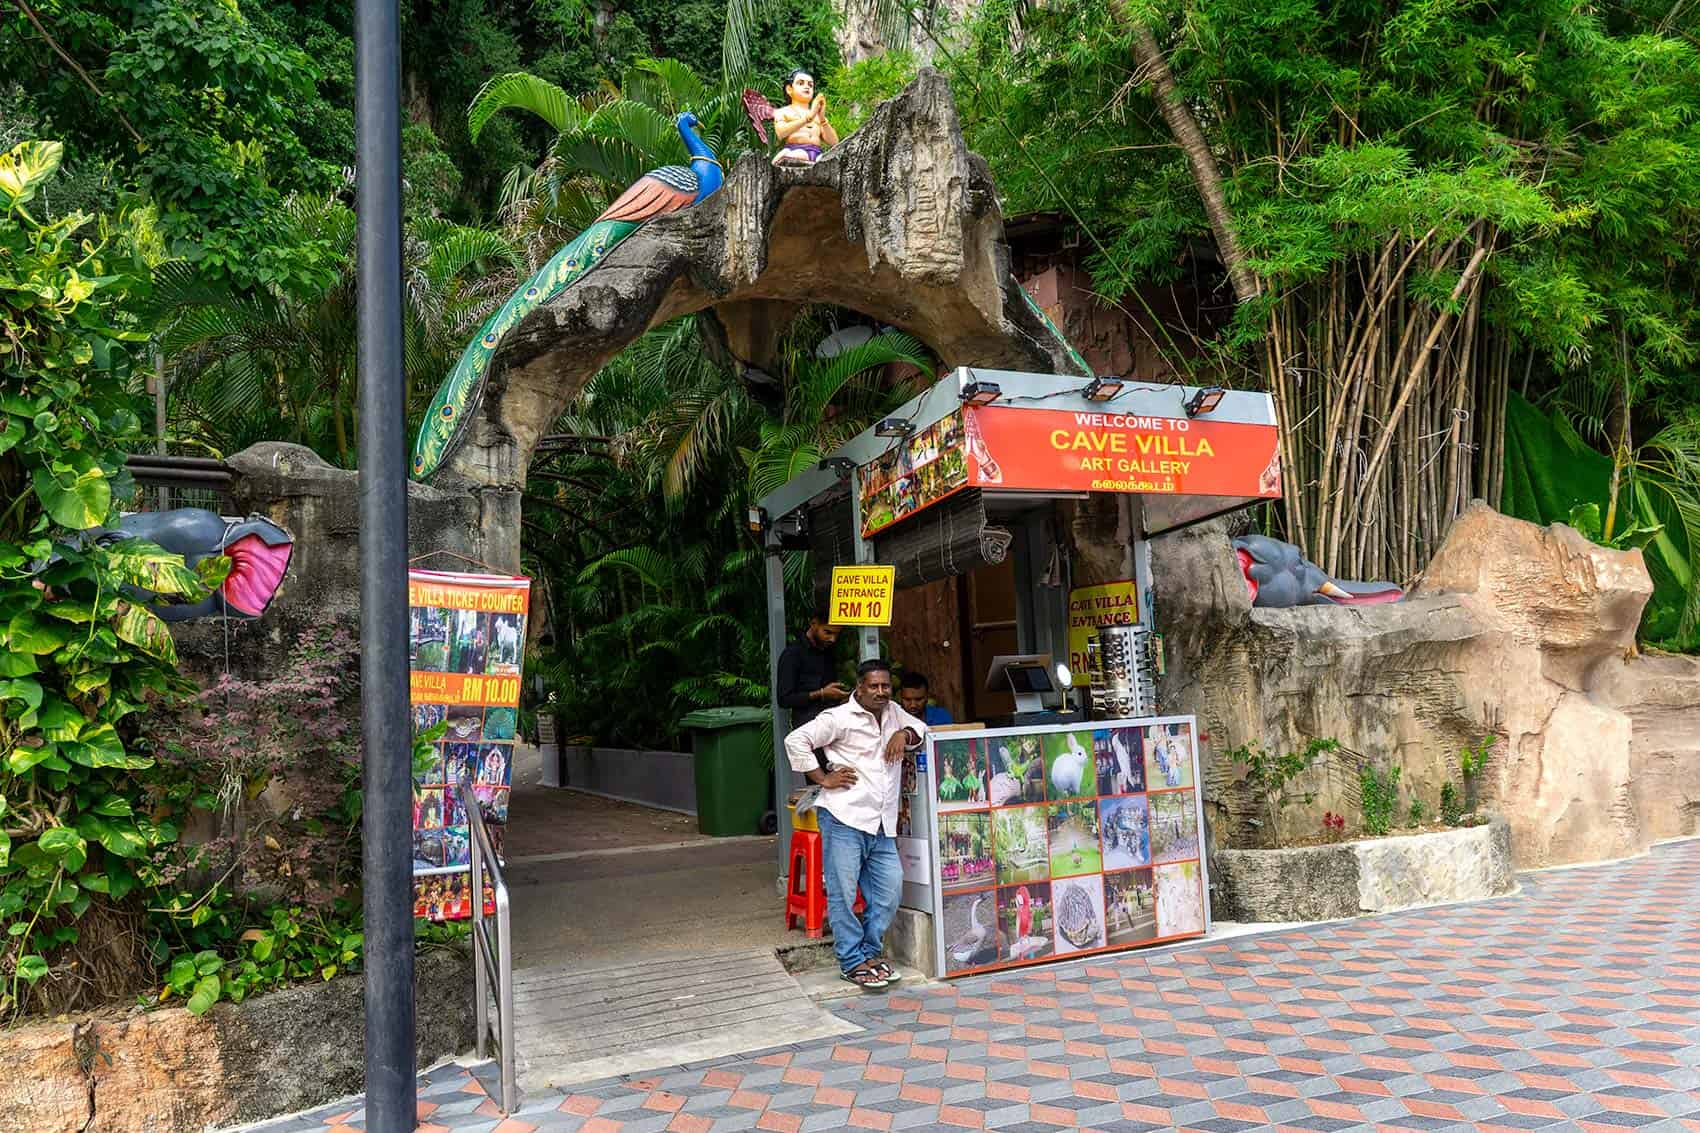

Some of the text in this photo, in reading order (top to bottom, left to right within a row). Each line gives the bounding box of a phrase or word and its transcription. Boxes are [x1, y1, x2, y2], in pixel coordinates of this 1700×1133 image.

[1074, 413, 1189, 432] WELCOME TO
[1050, 429, 1215, 457] CAVE VILLA
[1079, 458, 1191, 475] ART GALLERY
[837, 575, 888, 584] CAVE VILLA
[418, 586, 444, 605] VILLA
[447, 590, 479, 608] TICKET
[481, 593, 523, 611] COUNTER
[837, 588, 886, 598] ENTRANCE
[839, 601, 881, 618] RM 10
[1071, 594, 1134, 611] CAVE VILLA
[1071, 612, 1131, 627] ENTRANCE
[424, 674, 447, 689] VILLA
[462, 677, 483, 702] RM
[485, 678, 518, 704] 10.00
